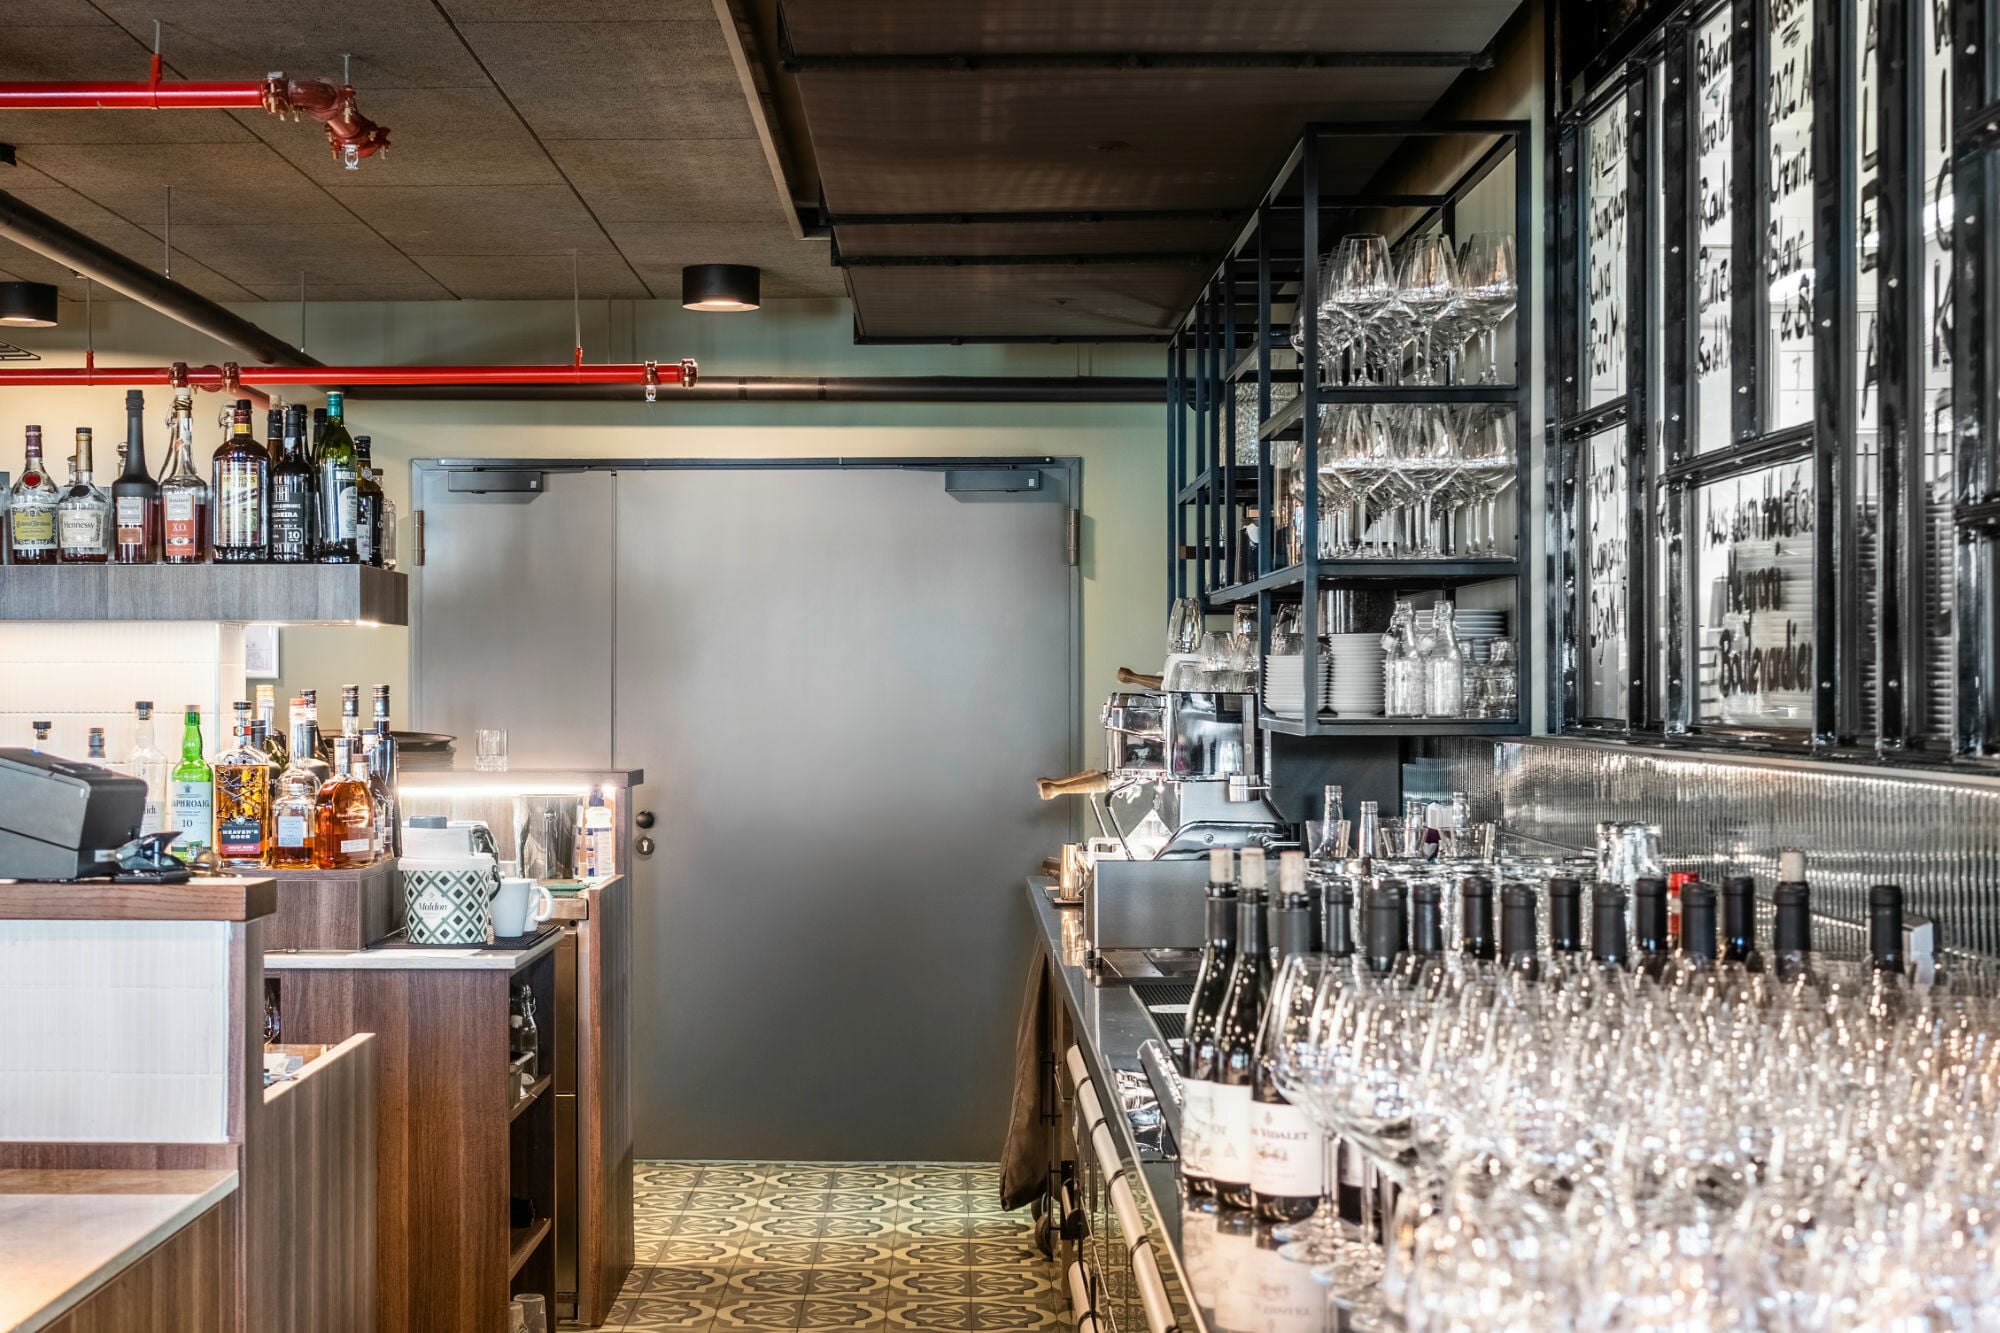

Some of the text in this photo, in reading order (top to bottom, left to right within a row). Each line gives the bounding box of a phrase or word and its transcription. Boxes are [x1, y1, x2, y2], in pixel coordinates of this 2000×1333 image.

[64, 520, 94, 529] Hennessy
[288, 531, 300, 539] 10
[182, 819, 193, 828] 10
[418, 902, 448, 911] Maldon
